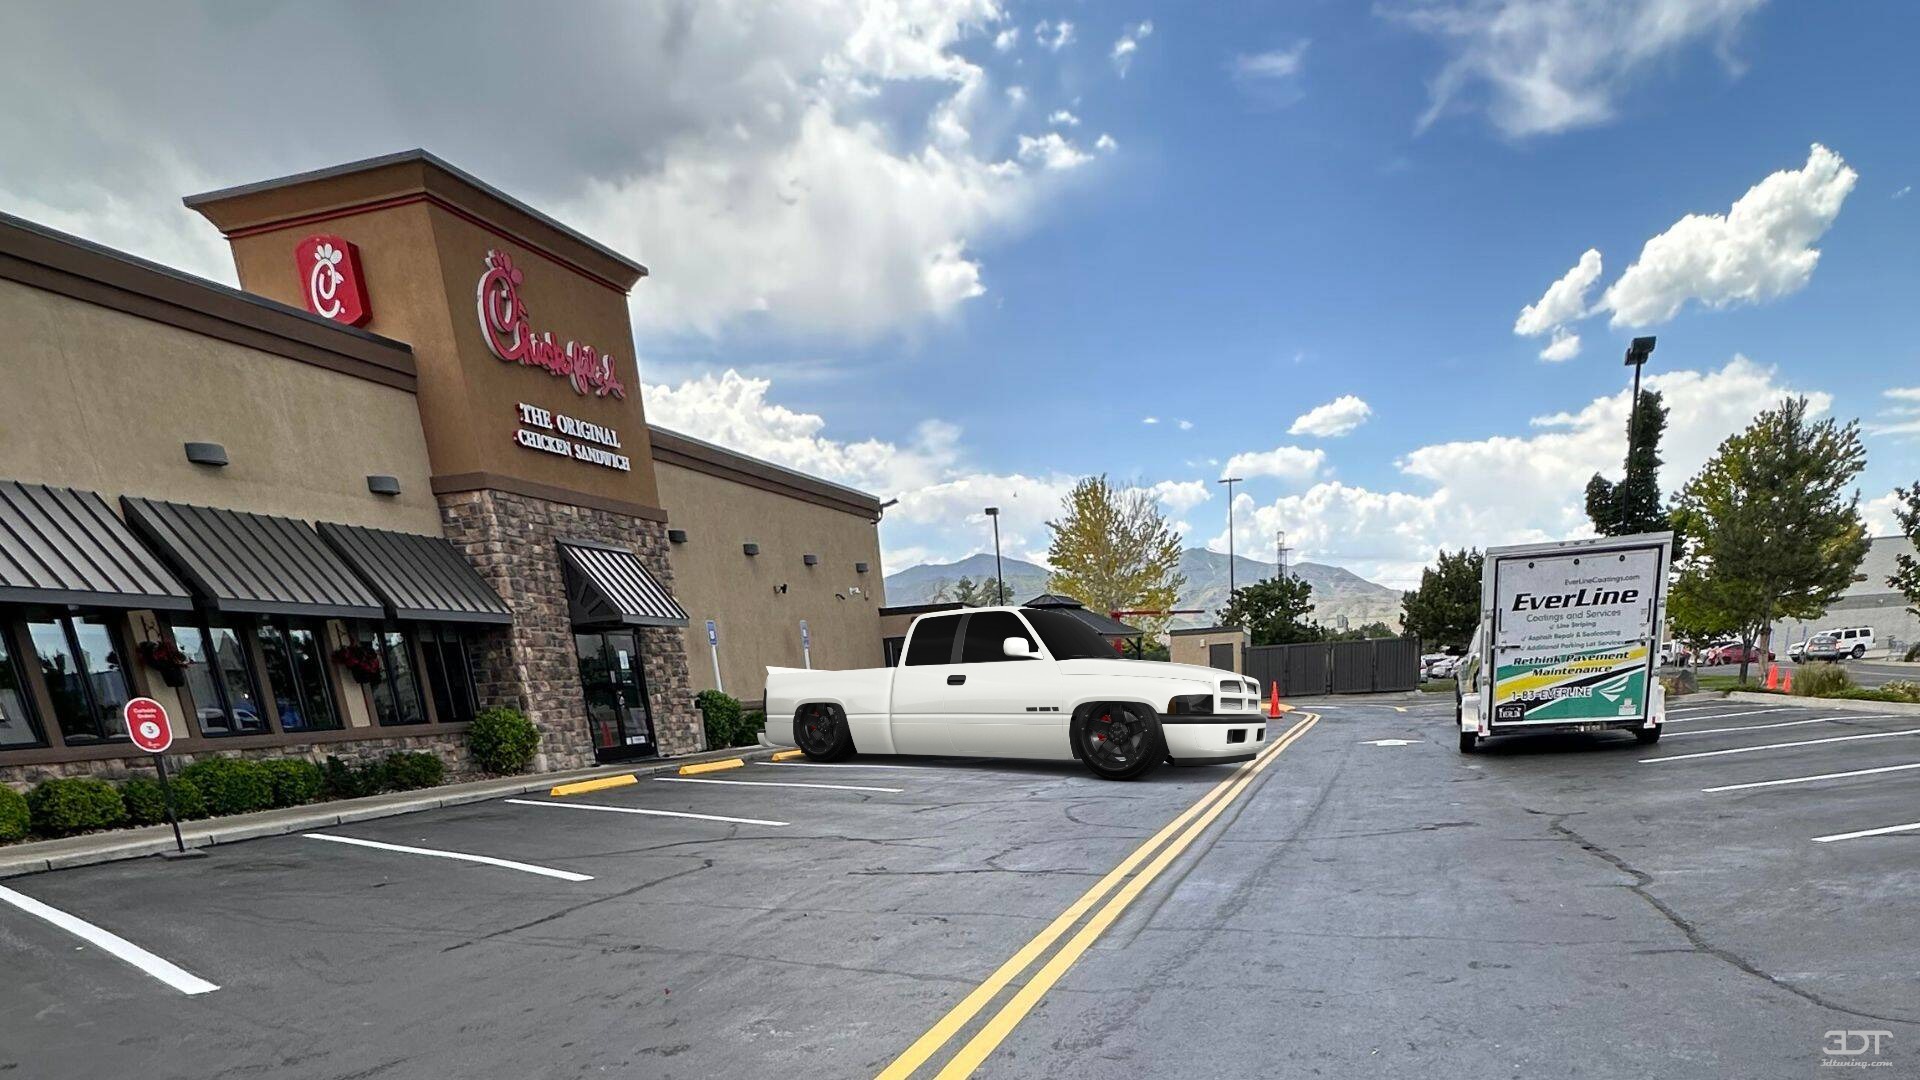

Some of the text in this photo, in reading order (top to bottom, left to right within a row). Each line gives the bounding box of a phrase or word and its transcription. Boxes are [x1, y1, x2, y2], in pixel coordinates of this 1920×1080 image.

[519, 402, 621, 449] THE ORIGINAL
[516, 429, 631, 472] CHICKEN SANDWICH
[1564, 574, 1640, 586] EverLineCoatings.com
[1512, 587, 1639, 612] EverLine
[1526, 609, 1621, 623] Coatings and Services
[1571, 621, 1597, 629] Striping
[1528, 633, 1552, 641] Asphalt
[1554, 632, 1574, 640] Repair
[1582, 629, 1621, 638] Sealcoating
[1526, 643, 1560, 651] Additional
[1560, 641, 1585, 649] Parking
[1513, 651, 1630, 666] Rethink Pavement
[1532, 664, 1612, 677] Maintenance
[146, 725, 155, 734] 3
